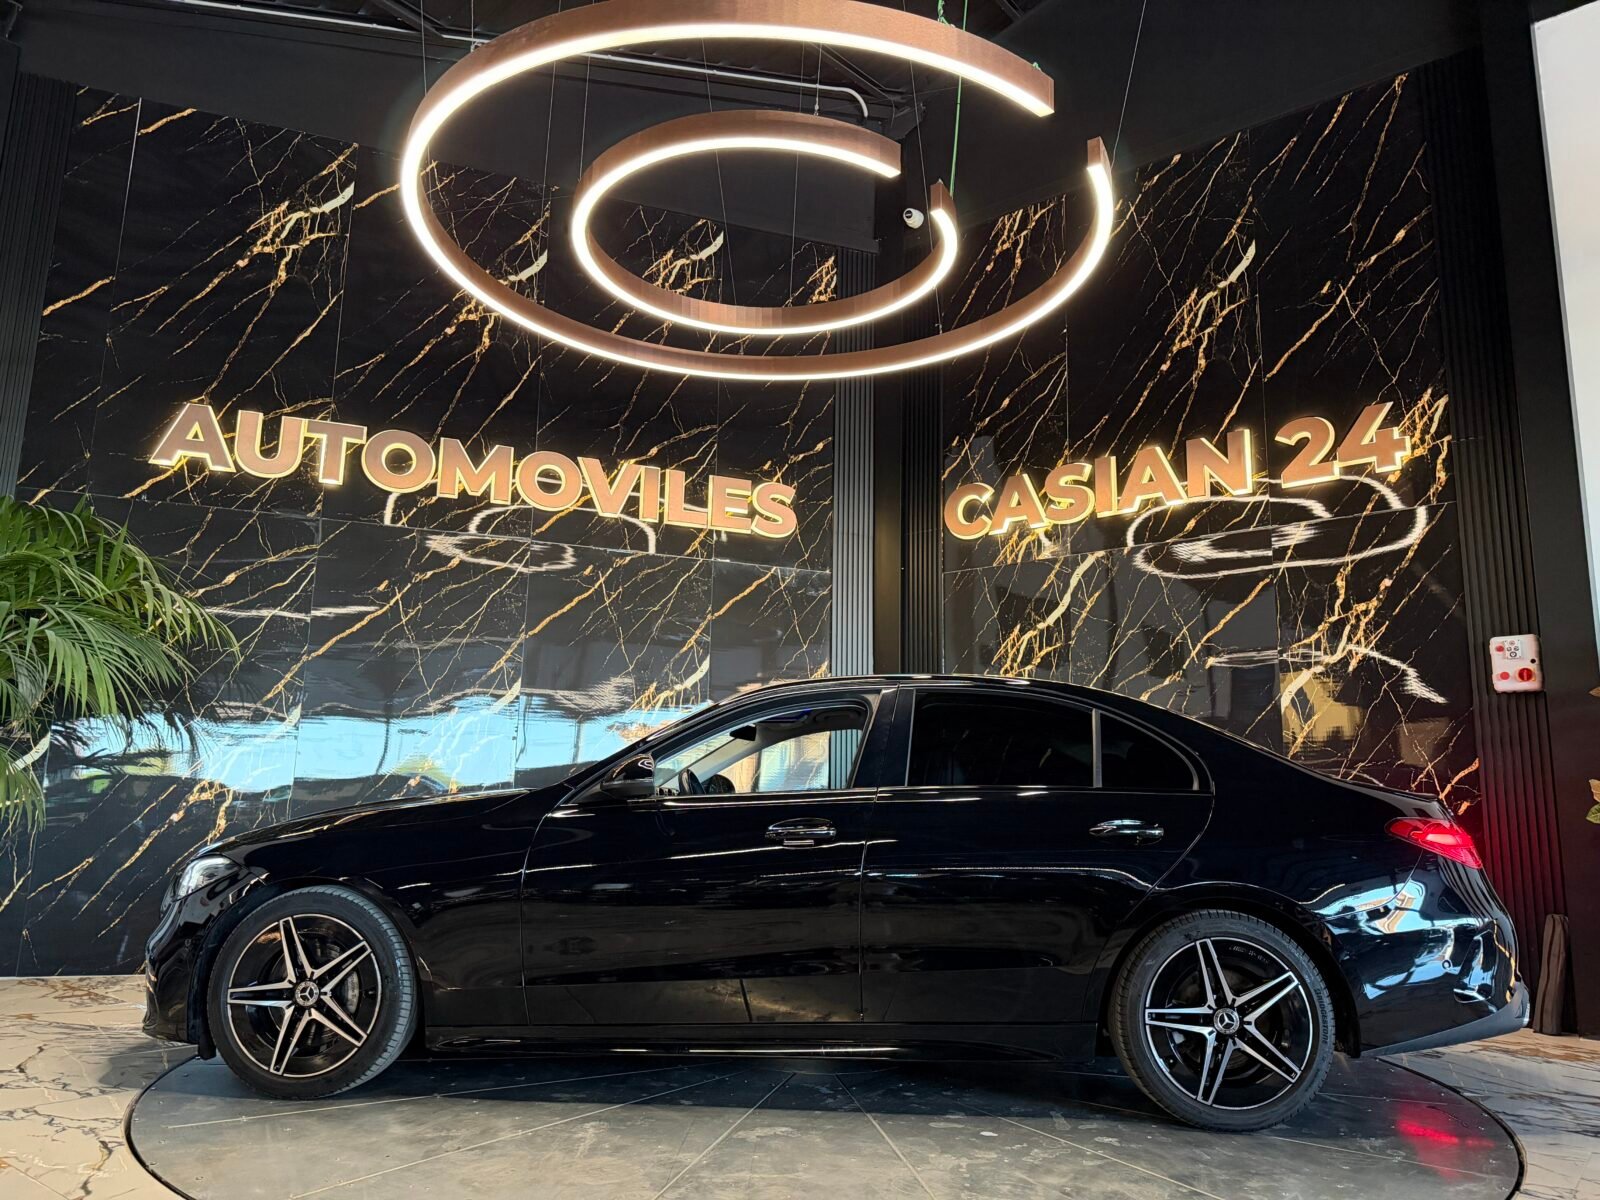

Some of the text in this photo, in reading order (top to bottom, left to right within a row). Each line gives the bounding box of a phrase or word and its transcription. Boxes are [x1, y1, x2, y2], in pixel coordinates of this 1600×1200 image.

[148, 402, 798, 539] AUTOMOVILES
[943, 401, 1411, 540] CASIAN 24
[1313, 988, 1329, 1044] BRIDGESTONE
